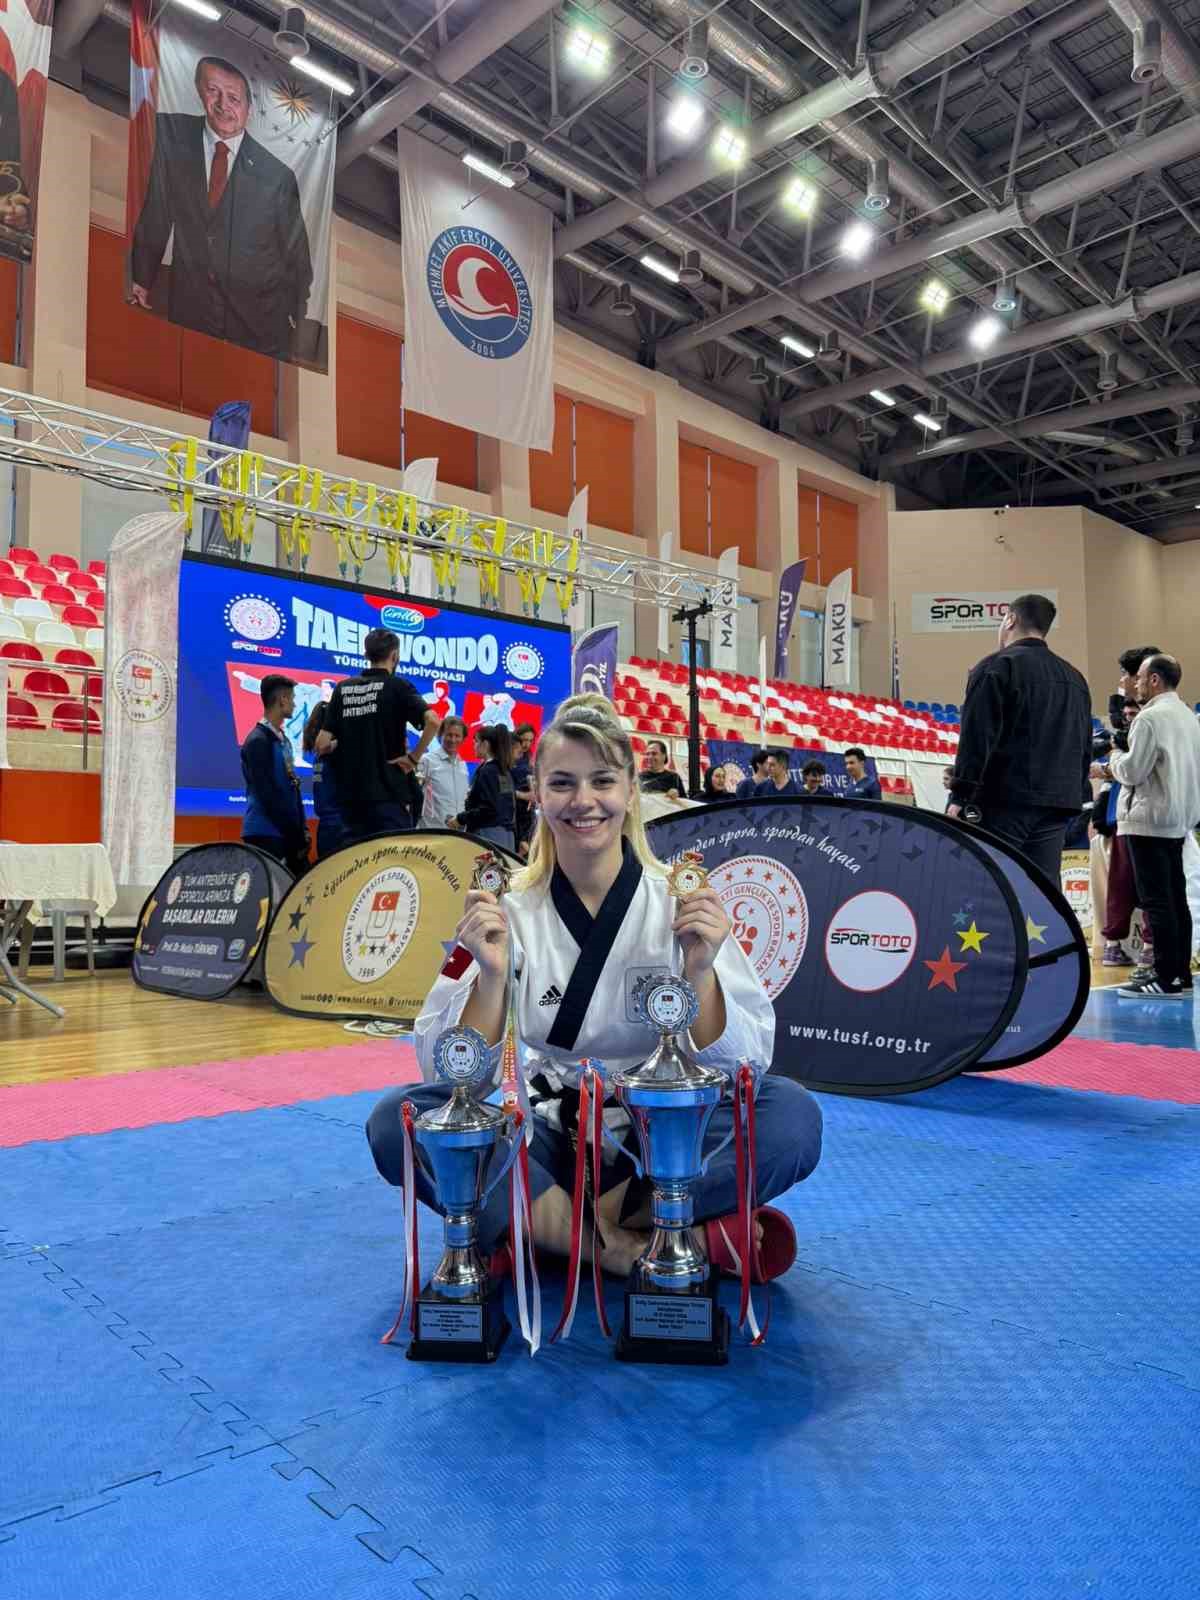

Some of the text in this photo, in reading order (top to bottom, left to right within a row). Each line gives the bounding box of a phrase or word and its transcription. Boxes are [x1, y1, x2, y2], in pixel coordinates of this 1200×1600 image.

[430, 253, 448, 308] MEHMET
[459, 229, 496, 253] ERSOY
[470, 340, 495, 357] 2006
[930, 603, 1010, 619] SPORTO
[832, 603, 846, 665] MAKÜ
[395, 664, 466, 683] AMPİYONASI
[835, 774, 849, 788] VE
[718, 825, 759, 847] spora,
[762, 825, 814, 848] spordan
[816, 835, 862, 875] hayata
[400, 844, 436, 863] spordan
[436, 855, 461, 893] hayata
[162, 909, 204, 926] BAŞARILAR
[771, 910, 781, 937] SPOR
[830, 932, 912, 948] SPORTOTO
[789, 1025, 931, 1053] www.tusf.org.tr
